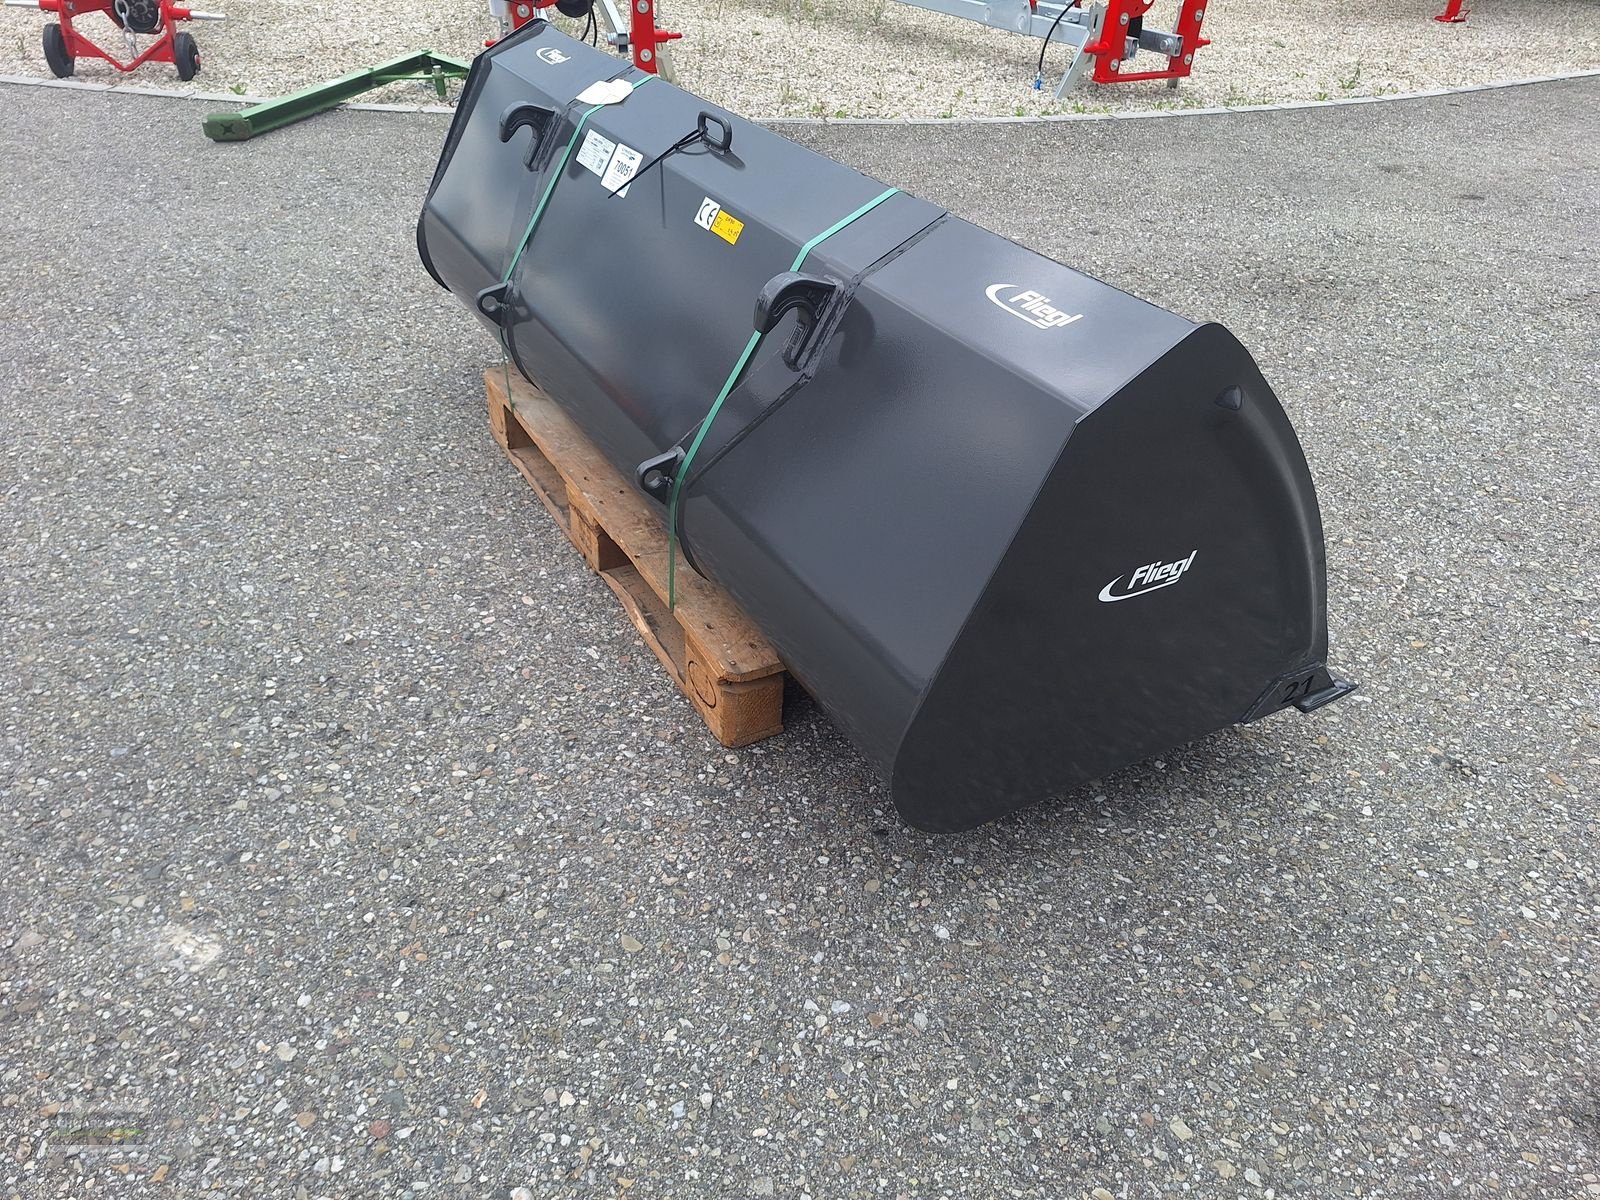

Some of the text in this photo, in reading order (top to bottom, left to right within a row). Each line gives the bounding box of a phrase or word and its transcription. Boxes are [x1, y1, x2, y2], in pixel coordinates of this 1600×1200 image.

[614, 159, 634, 178] 70051
[699, 202, 718, 226] CE
[1008, 290, 1084, 328] Fliegl
[1127, 549, 1198, 590] Fliegl
